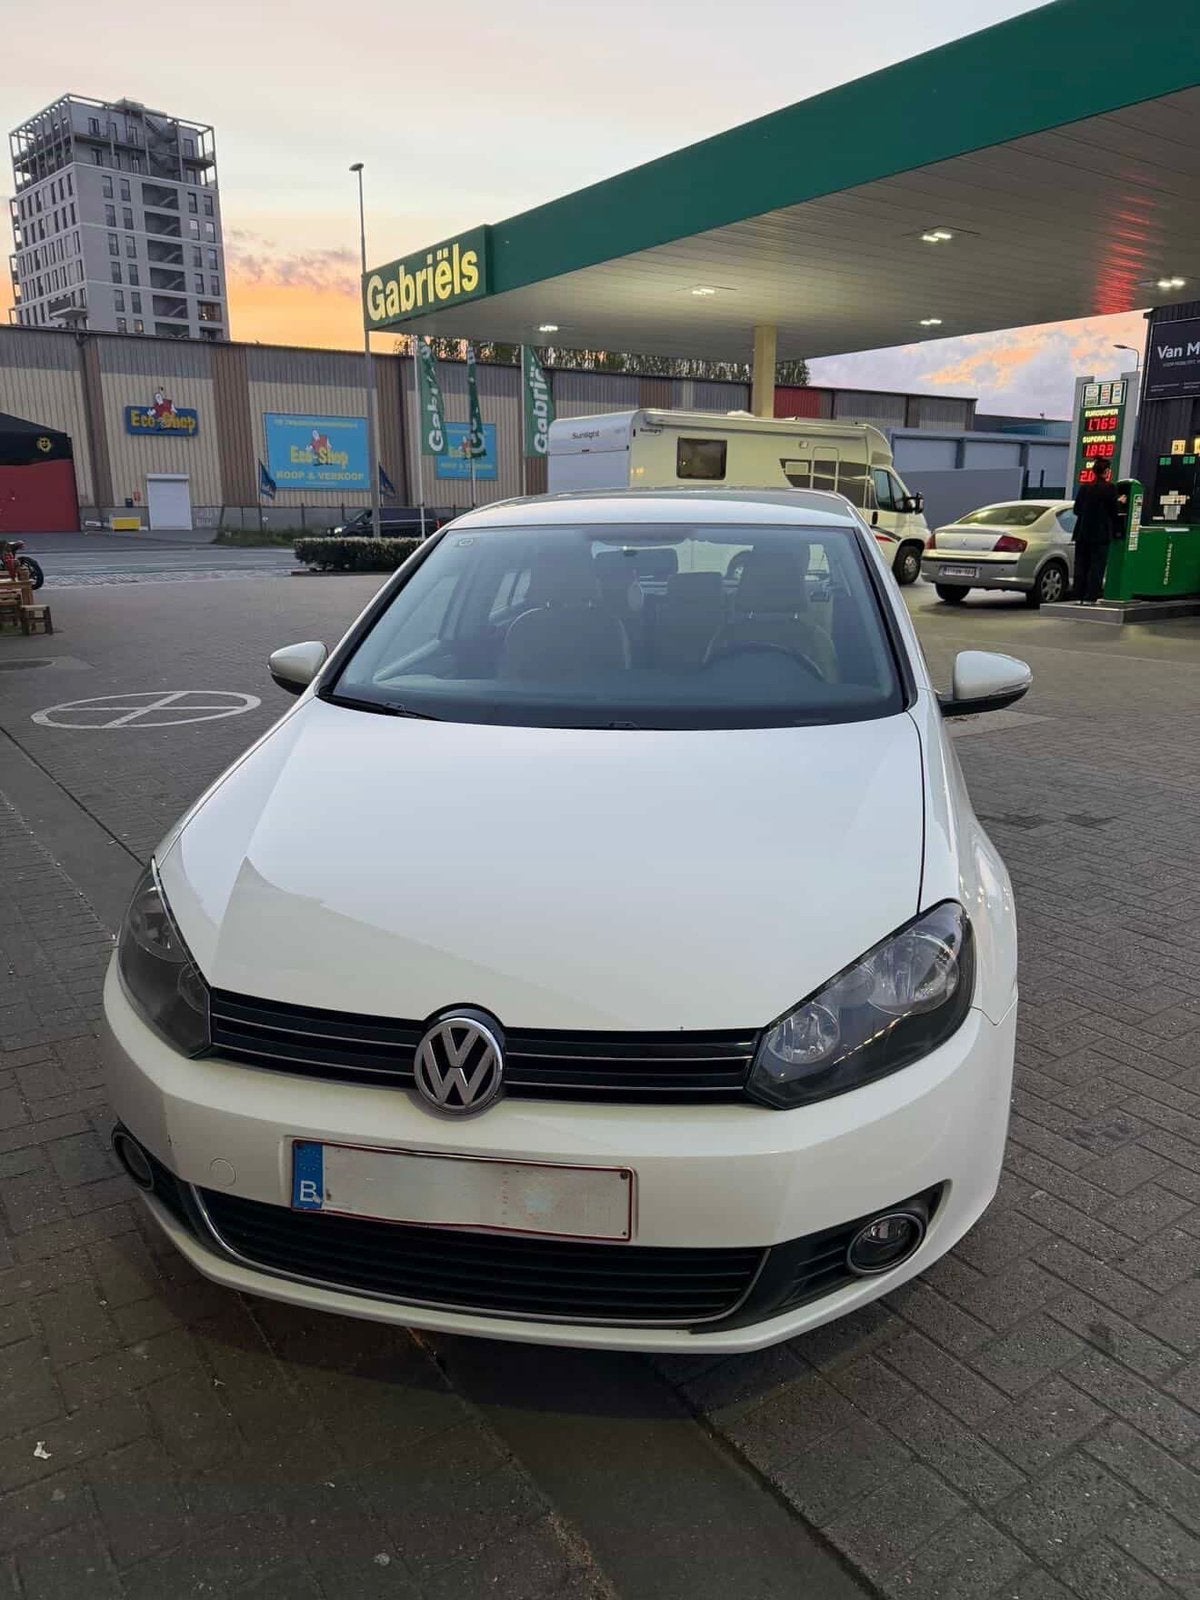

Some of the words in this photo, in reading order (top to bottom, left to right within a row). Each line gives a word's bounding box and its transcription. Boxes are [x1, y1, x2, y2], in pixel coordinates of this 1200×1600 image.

[367, 242, 480, 321] Gabriëls
[1157, 344, 1183, 360] Van
[571, 427, 600, 441] Sunlight
[276, 471, 304, 480] KOOP
[419, 1023, 498, 1109] VW
[299, 1179, 317, 1202] B
